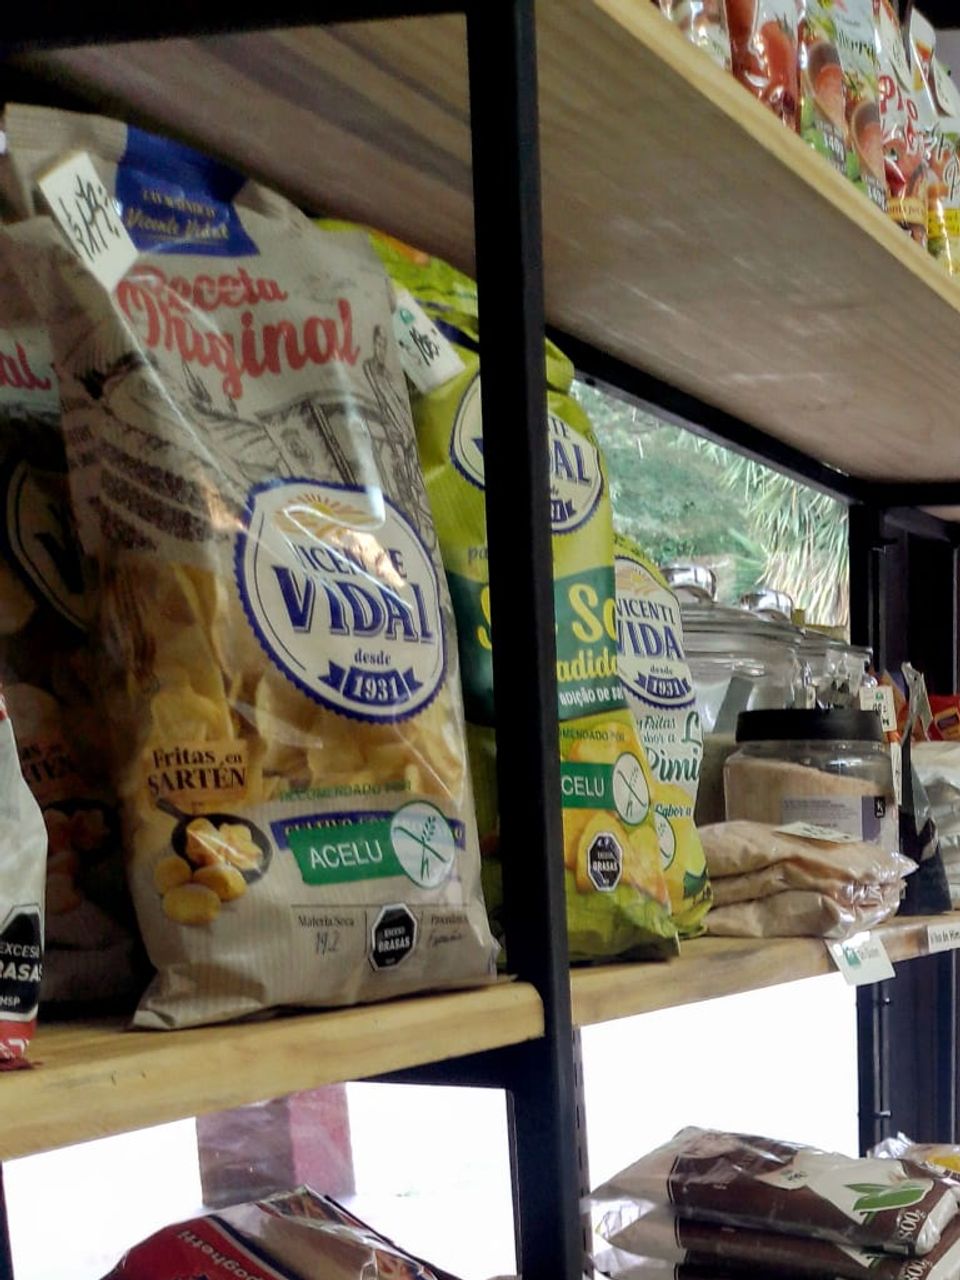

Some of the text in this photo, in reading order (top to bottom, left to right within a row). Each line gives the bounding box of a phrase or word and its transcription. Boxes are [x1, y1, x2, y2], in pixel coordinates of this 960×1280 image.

[272, 566, 435, 645] VIDAL
[616, 619, 686, 660] VIDA
[354, 647, 392, 666] desde
[353, 675, 400, 700] 1931
[651, 679, 681, 696] 1931
[152, 746, 216, 770] Fritas
[560, 777, 606, 798] CELU
[309, 839, 384, 870] ACELU
